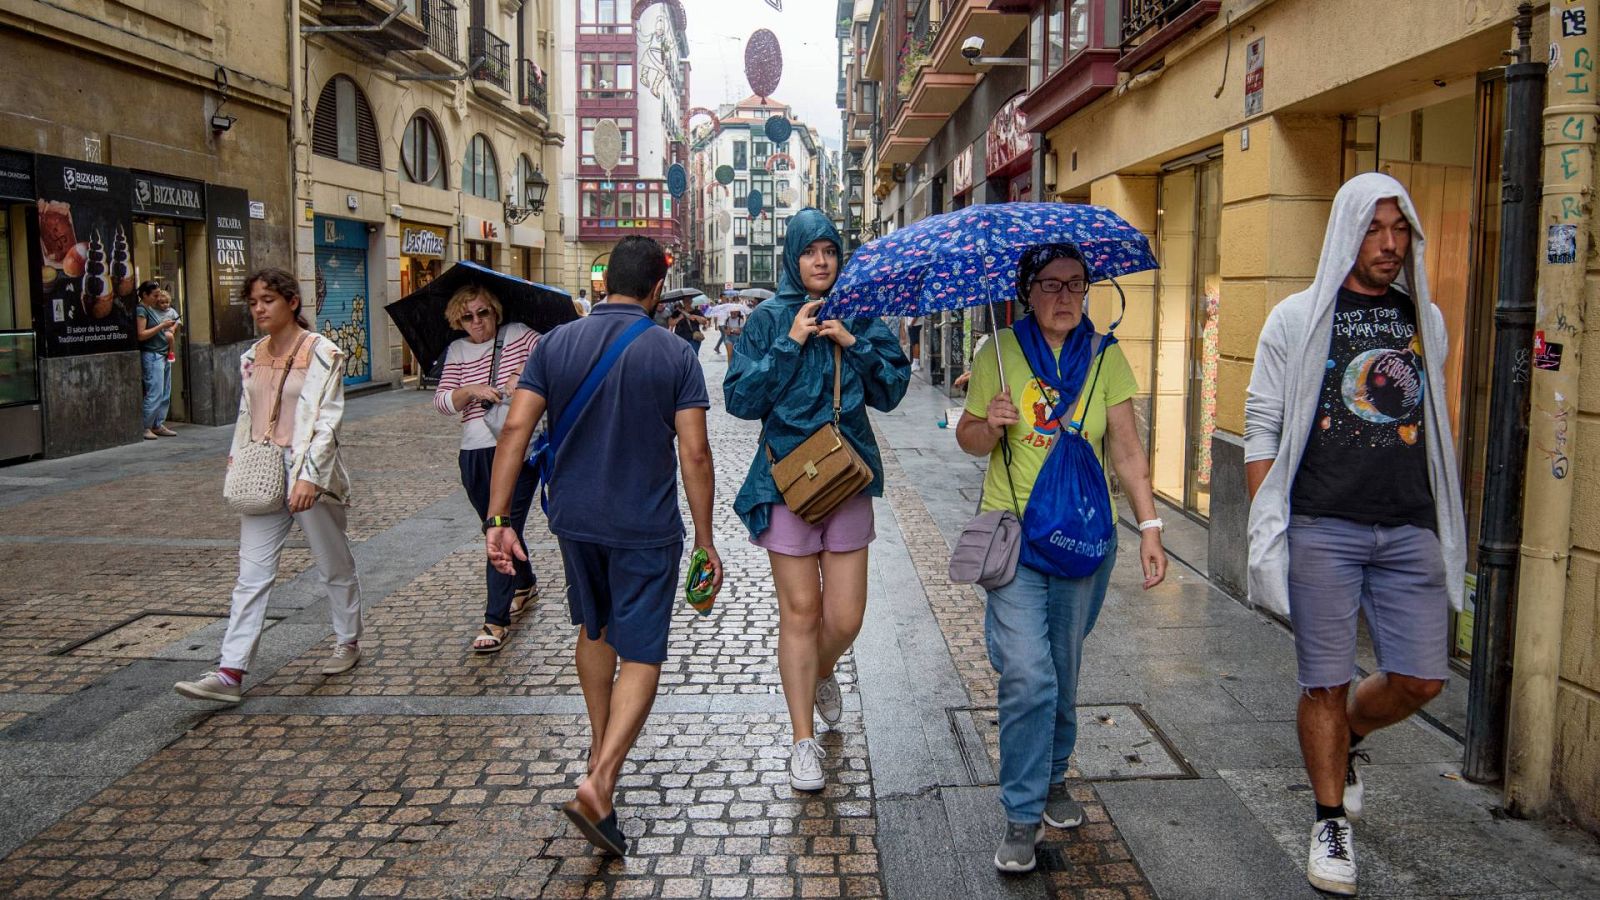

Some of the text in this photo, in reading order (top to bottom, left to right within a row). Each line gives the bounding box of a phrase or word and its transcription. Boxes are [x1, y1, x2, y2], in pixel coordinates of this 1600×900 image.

[76, 172, 108, 186] BIZKARRA
[153, 185, 201, 208] BIZKARRA
[1049, 529, 1076, 551] Gure
